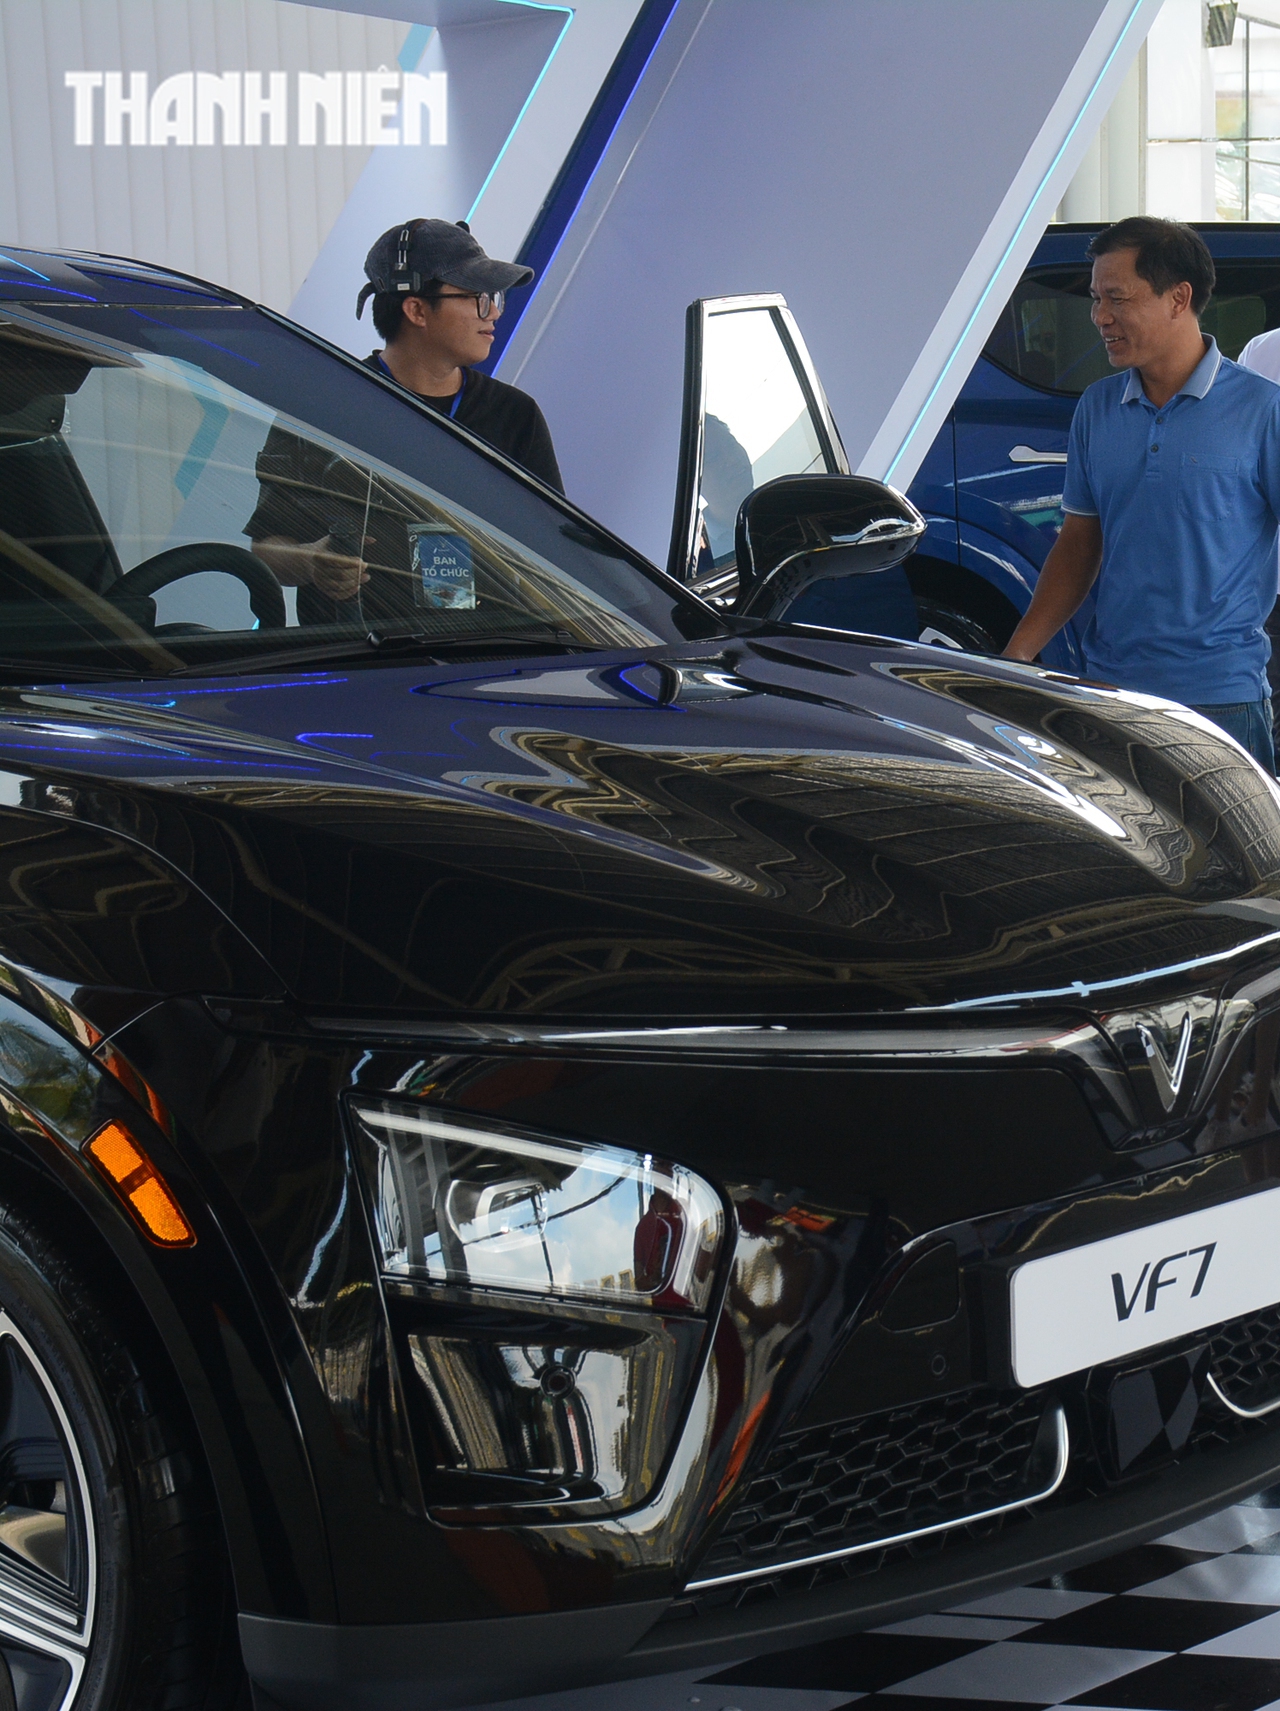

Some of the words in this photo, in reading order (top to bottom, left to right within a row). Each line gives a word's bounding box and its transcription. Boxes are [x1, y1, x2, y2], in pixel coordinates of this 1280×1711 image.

[433, 556, 457, 565] BAN
[440, 566, 470, 578] CHỨC
[1111, 1241, 1217, 1322] VF7
